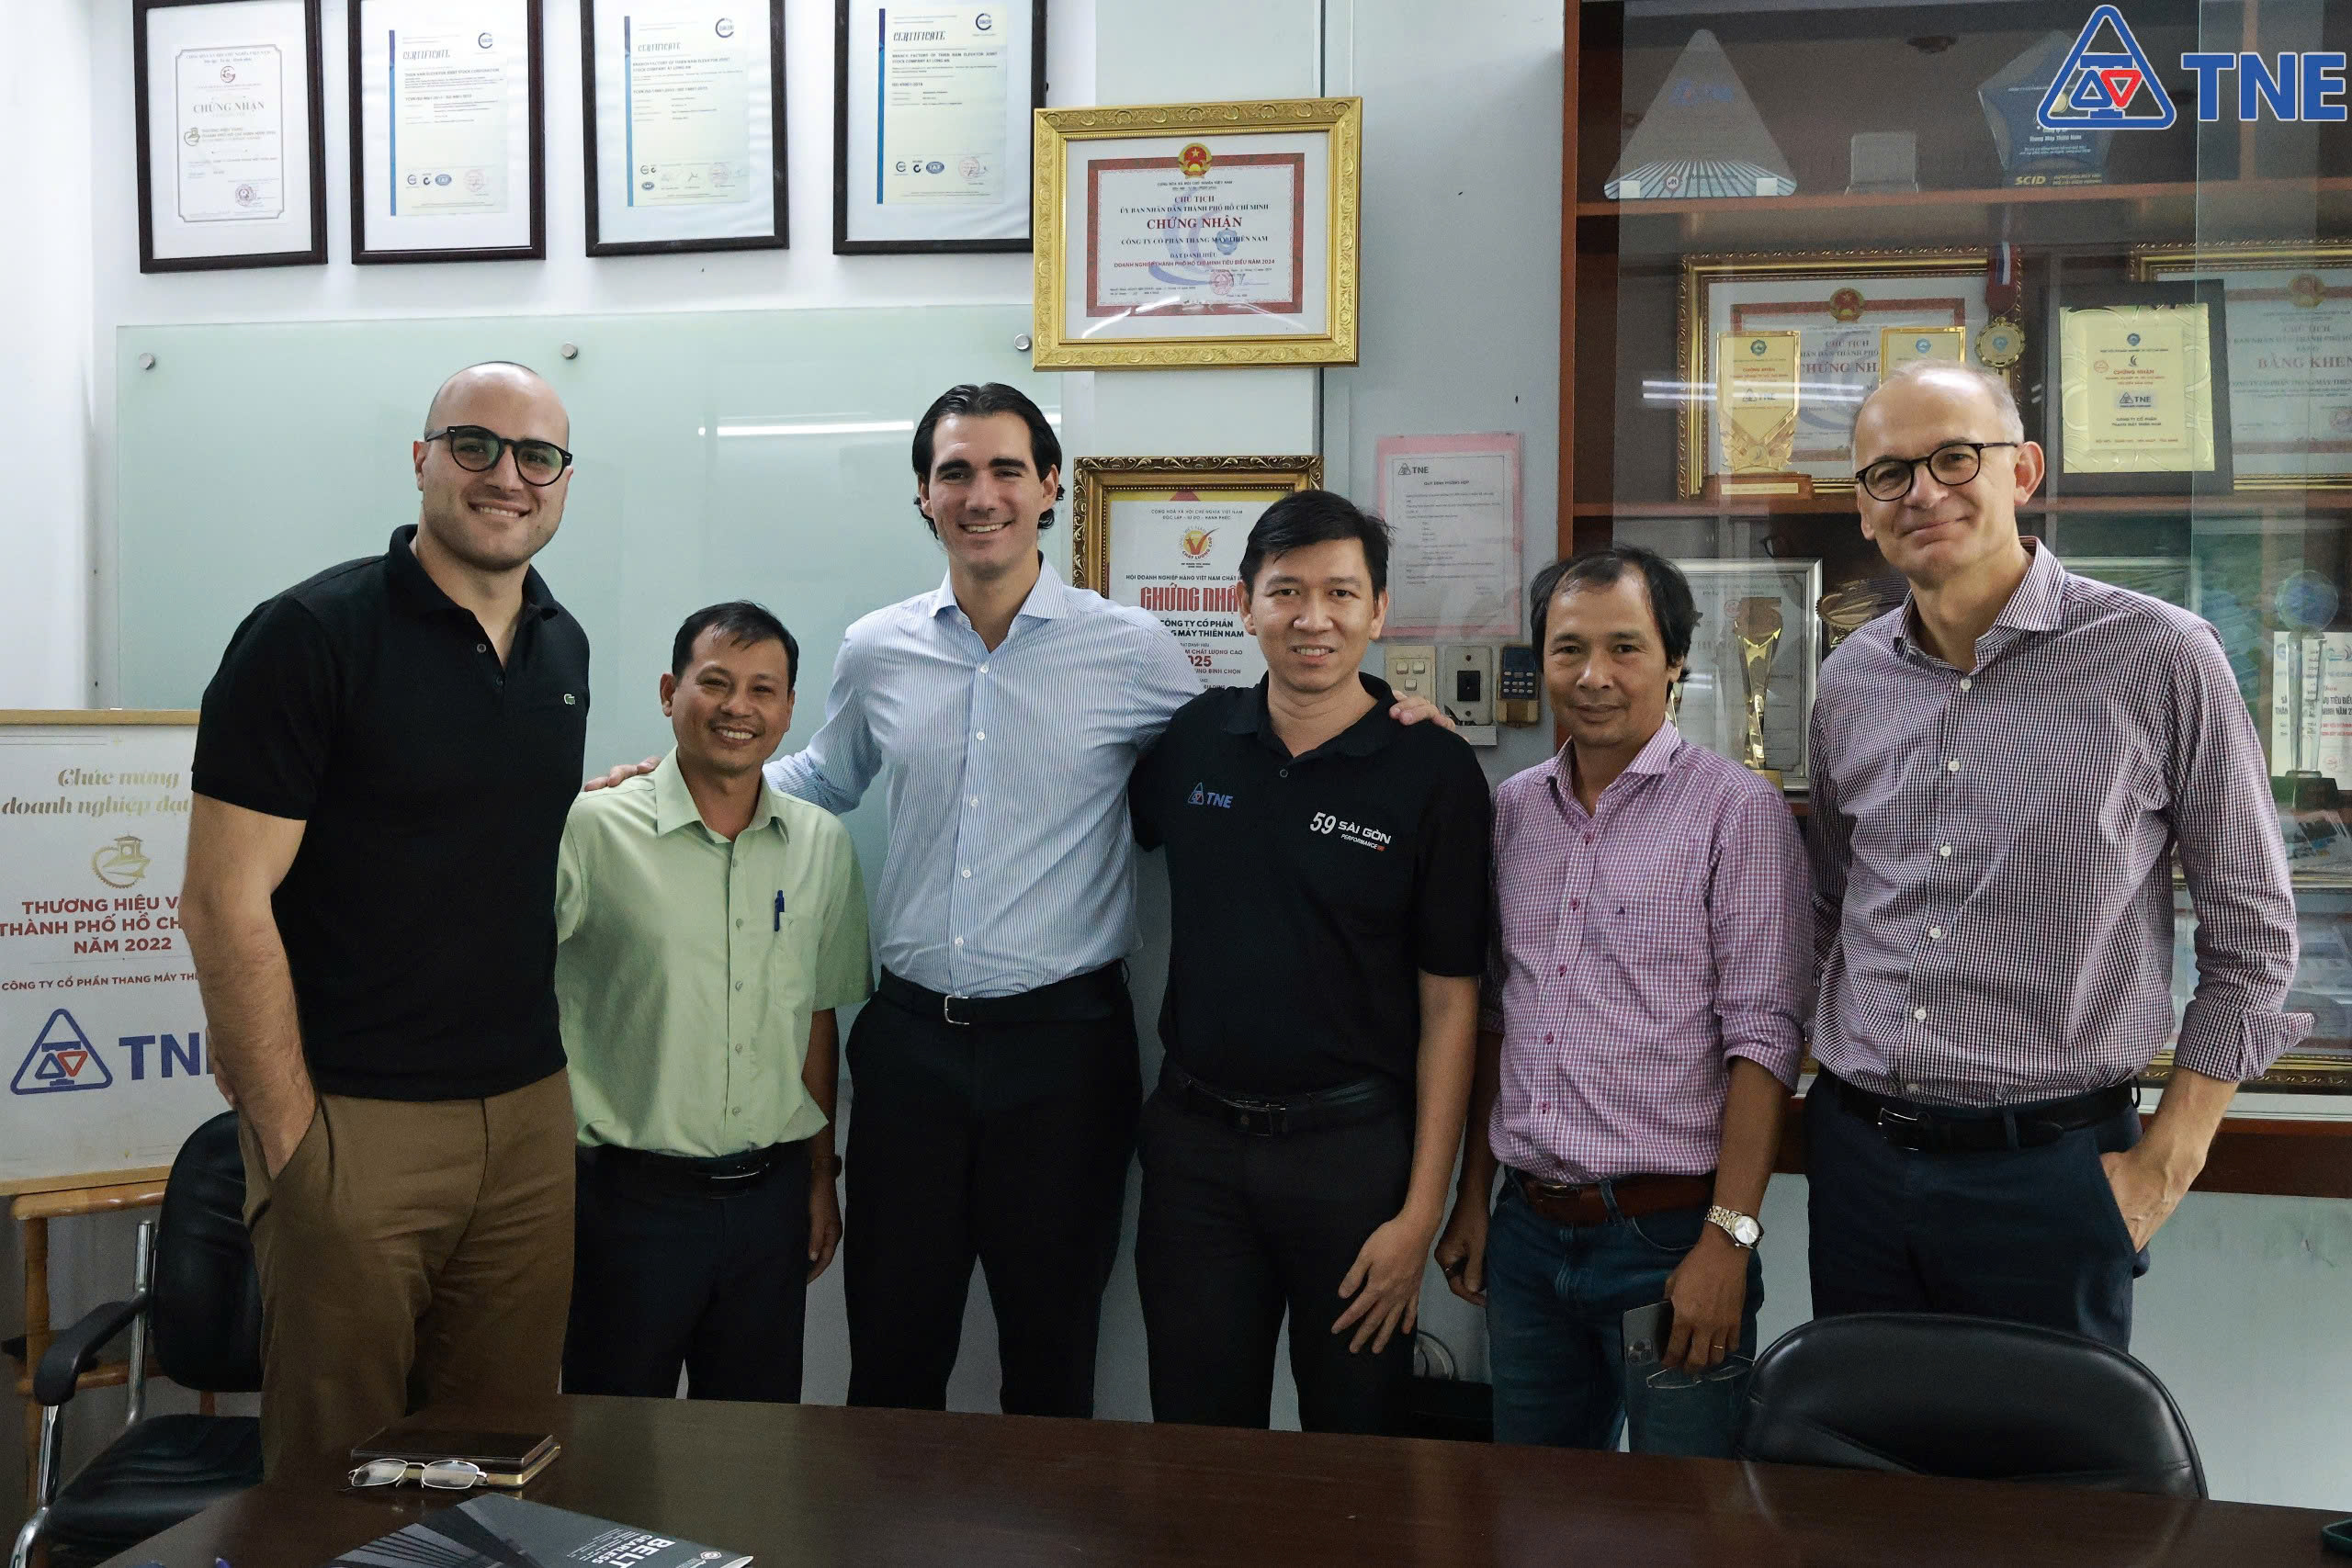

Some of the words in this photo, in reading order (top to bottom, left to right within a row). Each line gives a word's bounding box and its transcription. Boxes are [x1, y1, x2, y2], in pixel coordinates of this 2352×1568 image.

[893, 31, 946, 42] CERTIFICATE
[2015, 176, 2047, 185] SCID
[1147, 216, 1197, 229] CHỨNG
[1201, 215, 1243, 230] NHẬN
[1855, 362, 1880, 372] NH
[1141, 582, 1199, 612] CHỨNG
[1203, 585, 1238, 614] NHẬ
[1160, 618, 1183, 627] ÔNG
[1199, 628, 1223, 637] THIÊN
[1188, 655, 1212, 667] 25
[58, 768, 114, 787] Chúc
[2, 796, 74, 814] doanh
[1207, 792, 1233, 809] TNE
[1310, 812, 1336, 835] 59
[1338, 821, 1360, 834] SÀI
[1341, 834, 1378, 849] PERFORMANCE
[22, 898, 108, 915] THƯƠNG
[114, 894, 160, 914] HIỆU
[165, 897, 181, 909] V
[0, 919, 68, 936] THÀNH
[74, 914, 116, 933] PHỐ
[156, 916, 182, 930] CH
[74, 936, 119, 954] NĂM
[125, 937, 172, 952] 2022
[2, 980, 35, 991] CÔNG
[39, 980, 53, 989] TY
[112, 976, 151, 985] THANG
[154, 972, 177, 982] MÁY
[180, 973, 198, 981] THI
[592, 1534, 653, 1564] GEARLESS
[609, 1538, 676, 1568] BELT
